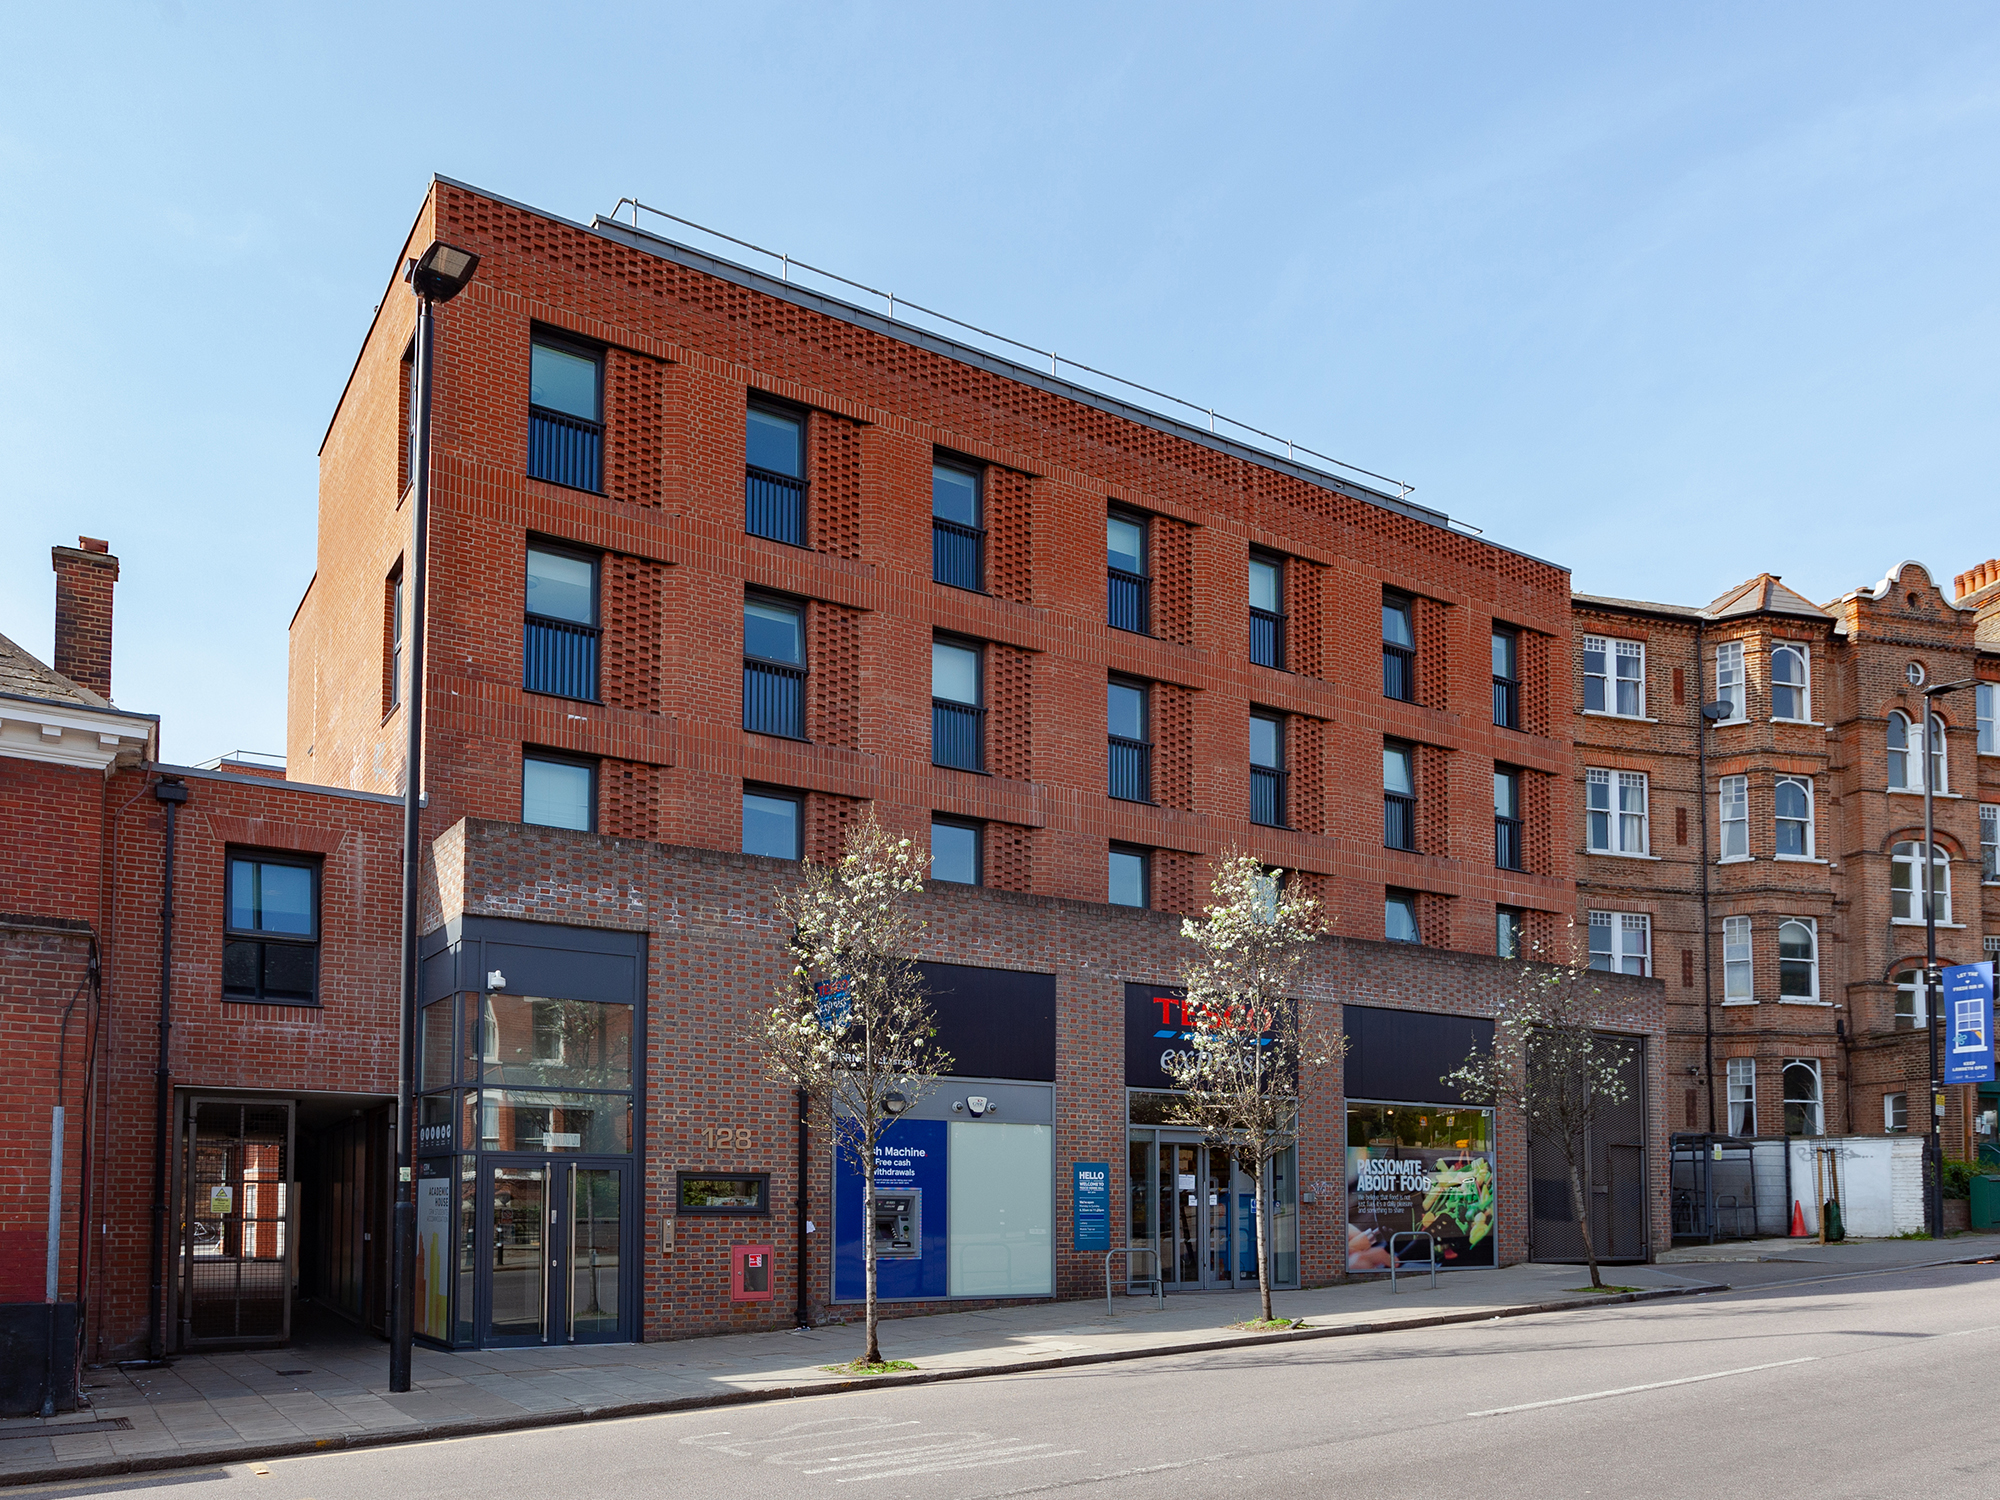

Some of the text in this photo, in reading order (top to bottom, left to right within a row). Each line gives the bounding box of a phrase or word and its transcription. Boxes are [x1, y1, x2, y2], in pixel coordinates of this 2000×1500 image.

[1153, 997, 1272, 1032] TESCO
[701, 1127, 752, 1151] 128
[875, 1158, 911, 1166] Free cash
[1357, 1159, 1421, 1175] PASSIONATE
[1079, 1172, 1104, 1180] HELLO
[1357, 1175, 1396, 1192] ABOUT
[1400, 1175, 1431, 1192] FOOD
[428, 1187, 449, 1196] ACADEMIC
[434, 1198, 449, 1207] HOUSE
